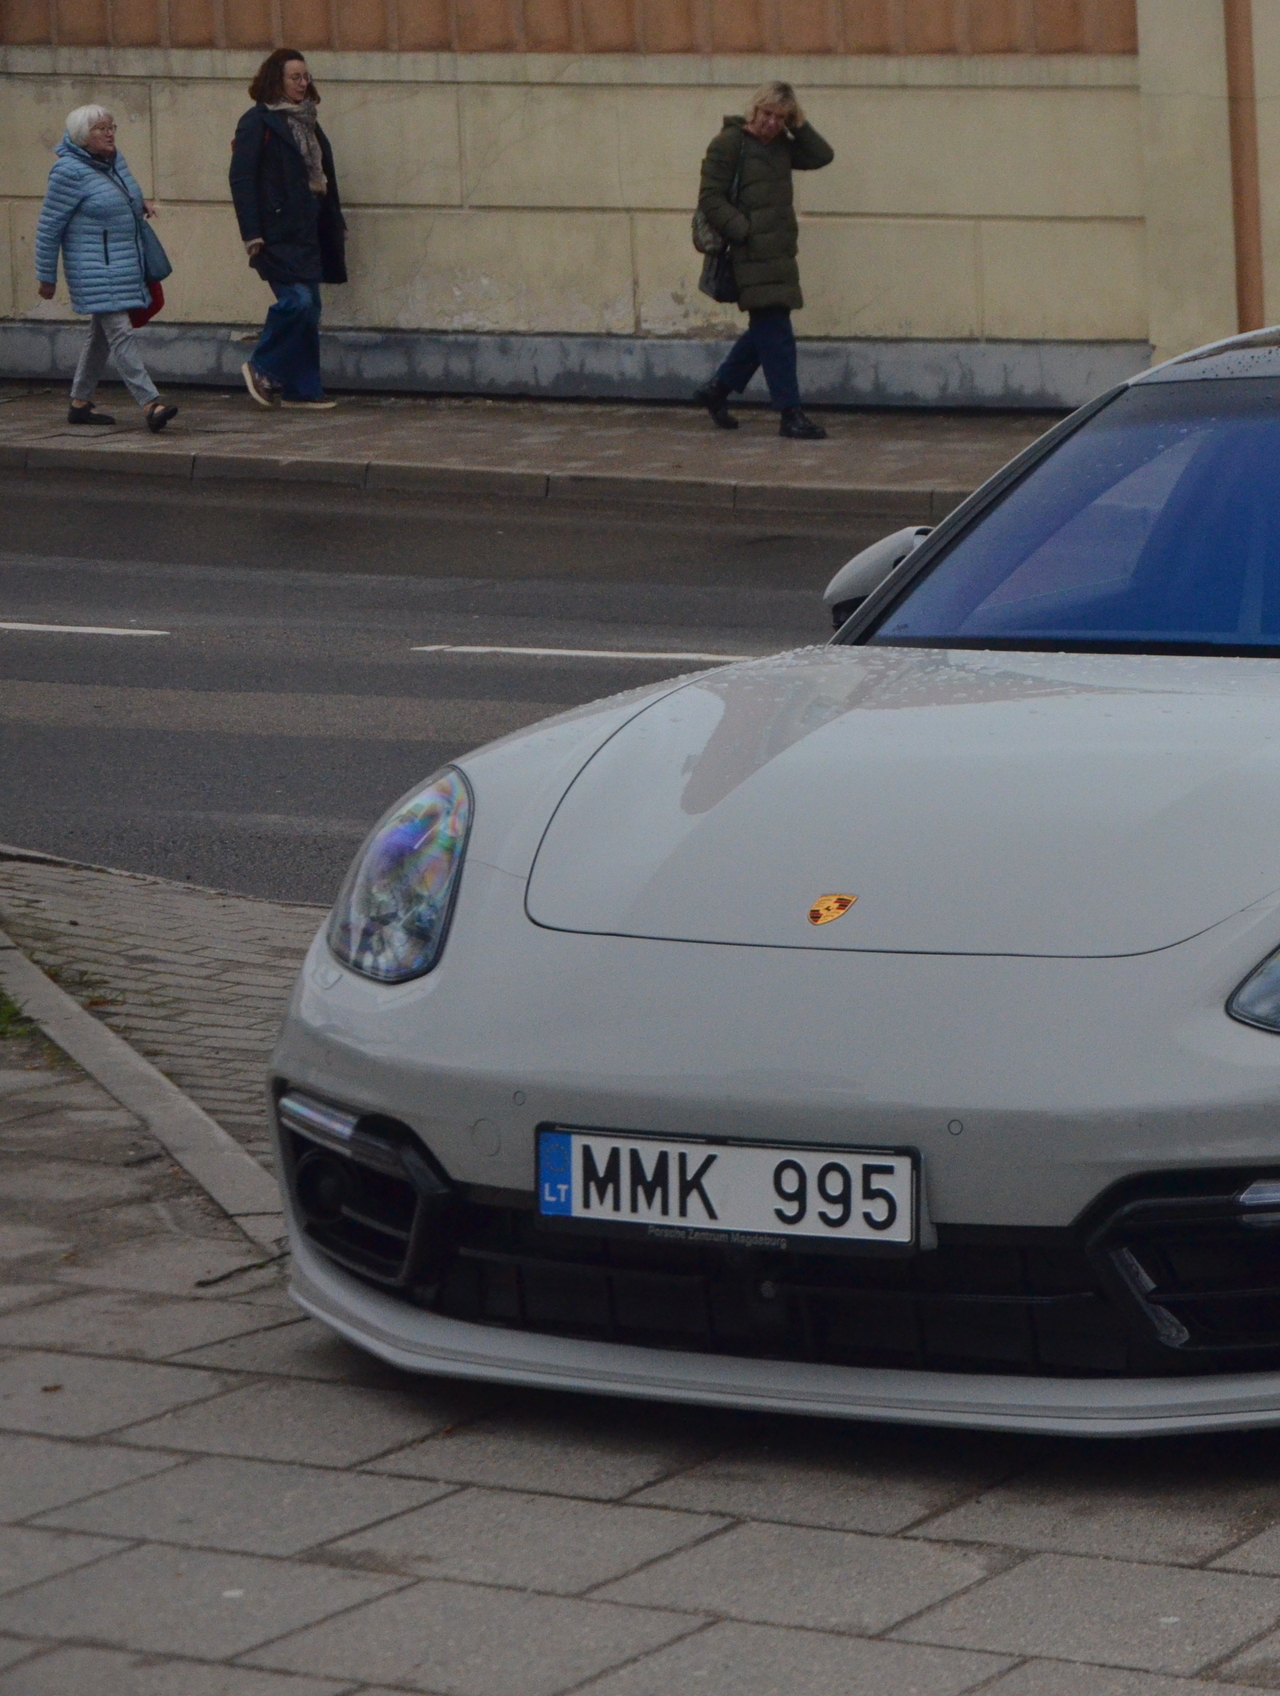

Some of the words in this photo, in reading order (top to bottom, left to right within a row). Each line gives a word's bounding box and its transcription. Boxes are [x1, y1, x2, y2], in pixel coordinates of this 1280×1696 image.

[544, 1183, 569, 1202] LT
[582, 1144, 719, 1220] MMK
[773, 1159, 897, 1230] 995
[648, 1225, 686, 1239] Porsche
[688, 1228, 729, 1242] Zentrum
[731, 1231, 788, 1249] Magdeburg
